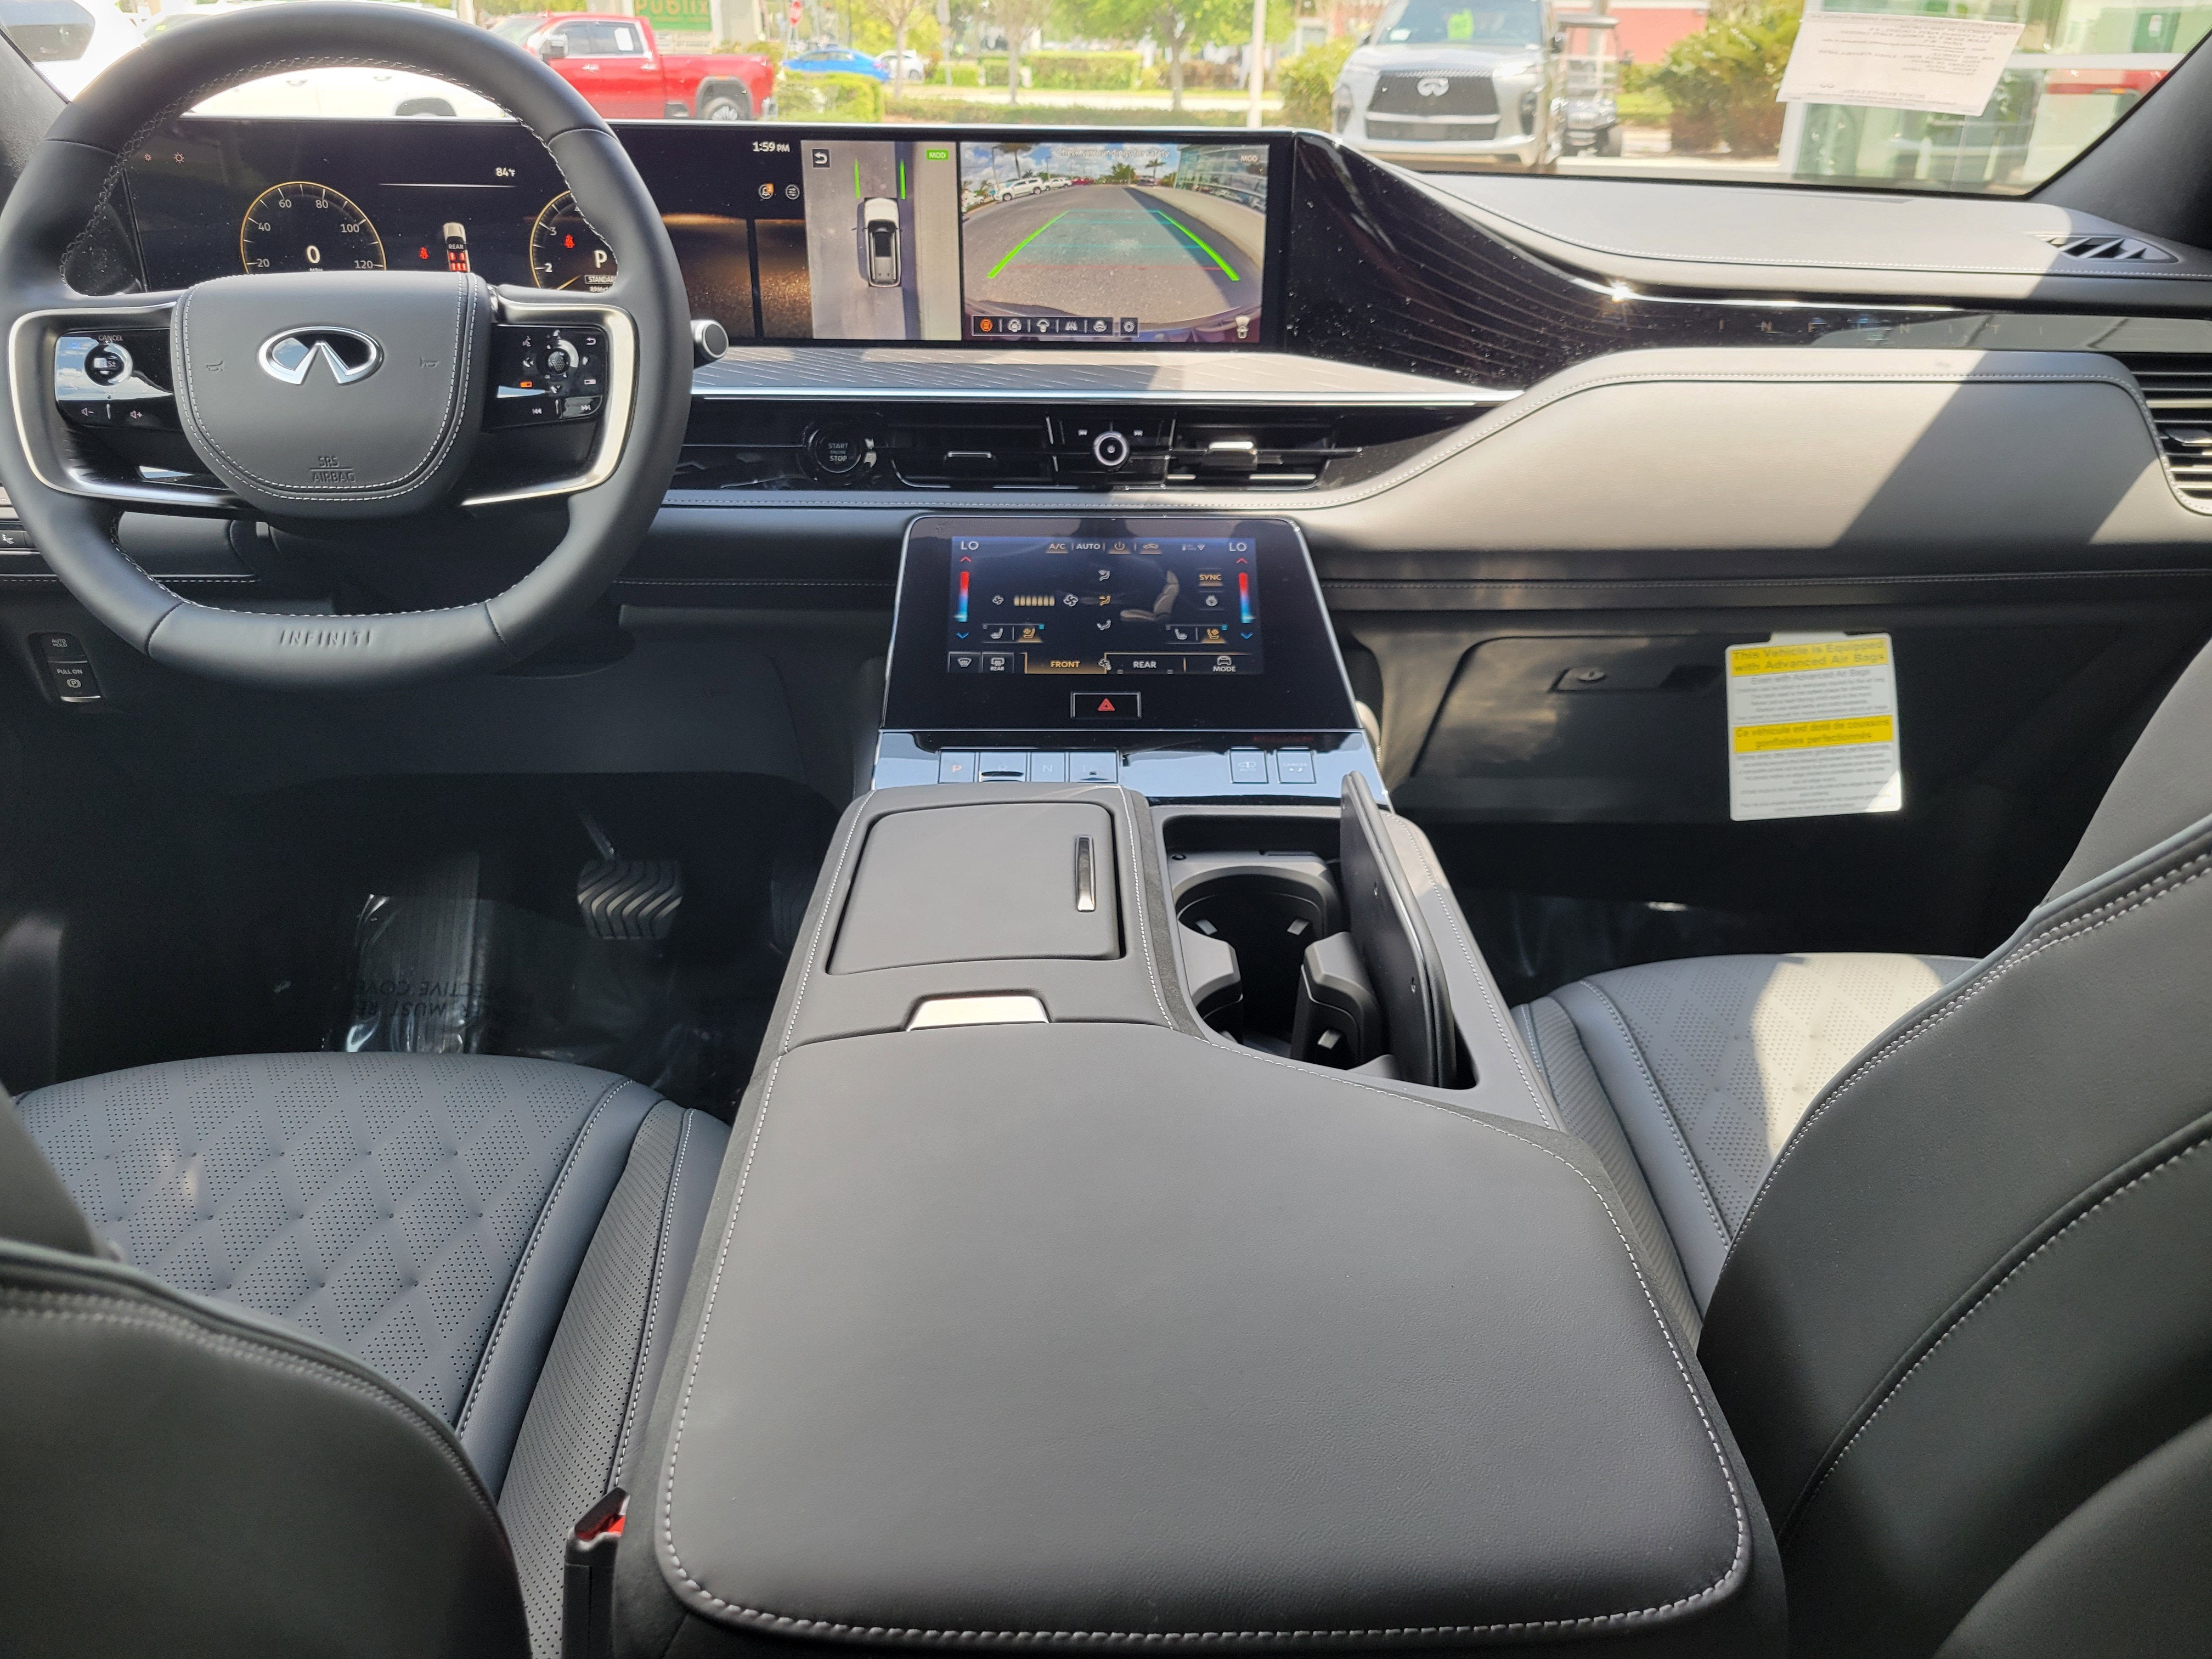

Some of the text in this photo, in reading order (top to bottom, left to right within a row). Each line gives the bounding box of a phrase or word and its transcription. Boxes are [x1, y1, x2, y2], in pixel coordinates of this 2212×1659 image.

[752, 141, 791, 153] 1:59 PM
[279, 199, 292, 208] 60
[315, 200, 329, 209] 80
[258, 222, 271, 232] 40
[340, 223, 360, 233] 100
[550, 226, 557, 236] 3
[306, 245, 320, 264] 0
[594, 250, 607, 268] P
[256, 258, 270, 268] 20
[354, 260, 374, 269] 120
[544, 262, 553, 273] 2
[318, 456, 339, 468] SRS
[313, 472, 356, 483] AIRBAG
[961, 541, 979, 550] LO
[1229, 543, 1247, 551] LO
[280, 629, 372, 647] INFINITI
[1733, 651, 1759, 660] This
[952, 764, 962, 772] P
